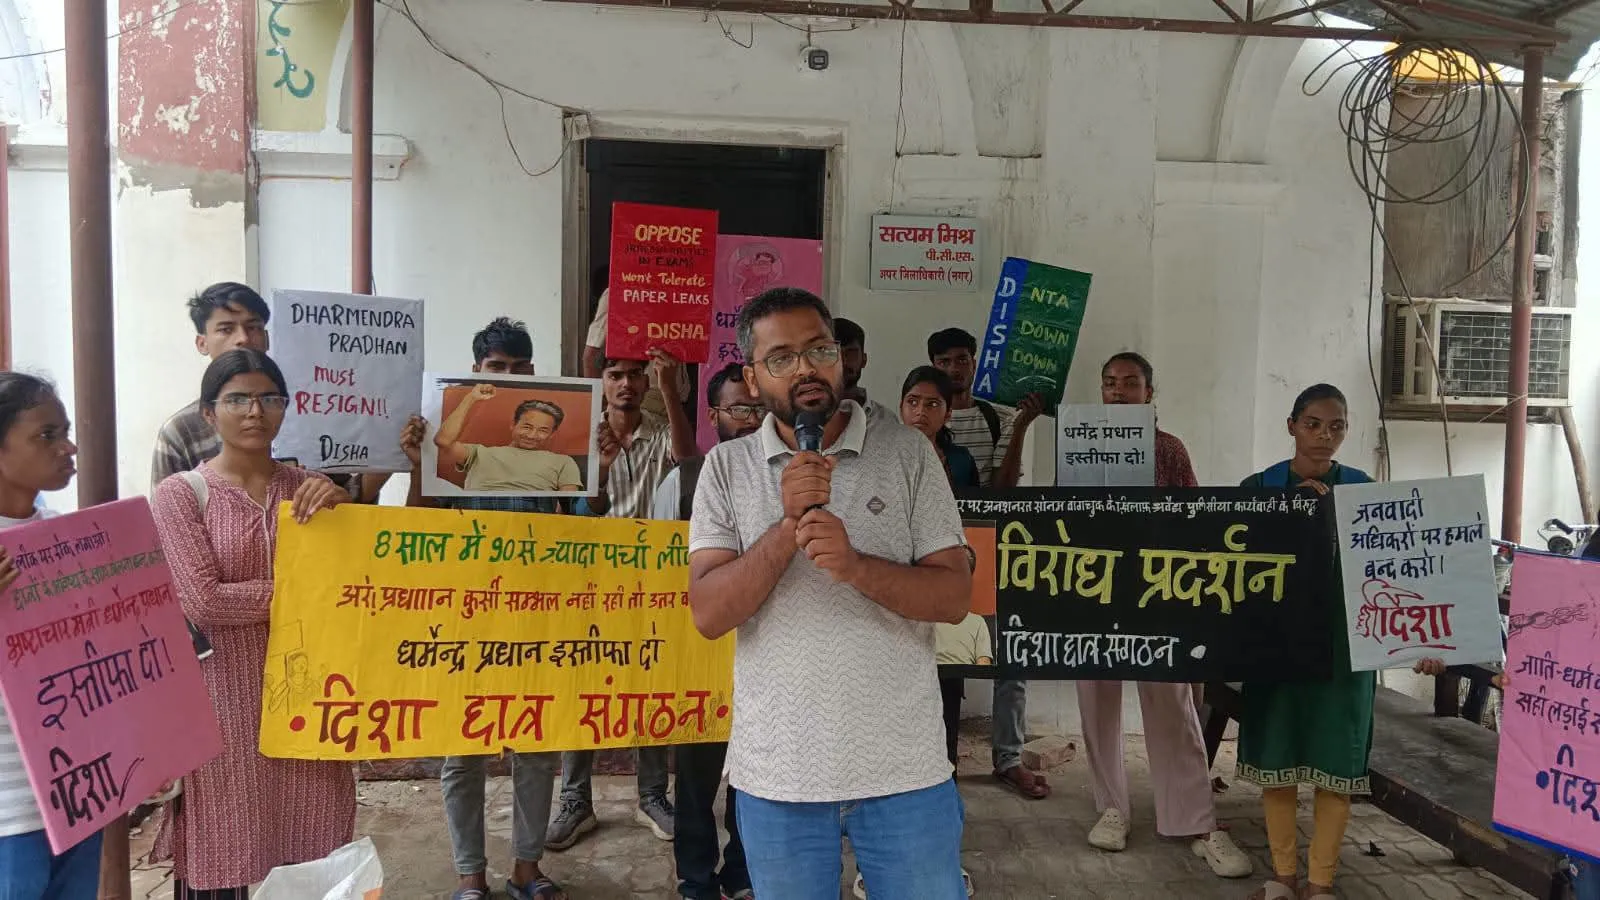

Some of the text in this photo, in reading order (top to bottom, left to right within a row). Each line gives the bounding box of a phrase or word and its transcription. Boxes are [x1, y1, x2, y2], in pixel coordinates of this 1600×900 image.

[635, 224, 703, 245] OPPOSE
[879, 223, 976, 244] सत्यम मिश्र
[926, 248, 974, 262] पी.सी.एस.
[622, 272, 706, 287] Won't Tolerate
[880, 266, 973, 285] अपर जिलाधिकारी (नगर)
[623, 289, 710, 305] PAPER LEAKS
[1030, 287, 1069, 309] NTA
[291, 303, 415, 329] DHARMENDRA
[328, 332, 408, 355] PRADHAN
[977, 276, 1016, 394] DISHA
[1020, 320, 1069, 346] DOWN
[1012, 349, 1058, 374] DOWN
[295, 391, 389, 419] RESIGN!!
[1102, 426, 1144, 439] प्रधान
[1065, 448, 1145, 466] इस्तीफा दो!
[983, 499, 1032, 514] अनशनरत
[1034, 494, 1065, 513] सोनम
[1278, 494, 1289, 513] के
[1352, 488, 1424, 525] जनवादी
[1422, 528, 1441, 545] पर
[1445, 511, 1486, 546] हमले
[395, 531, 455, 565] साल
[458, 519, 487, 561] में
[517, 523, 537, 566] से
[998, 519, 1296, 614] विरोध प्रदर्शन
[1365, 557, 1396, 580] बन्द
[504, 591, 561, 613] सम्भल
[565, 582, 598, 610] नहीं
[603, 584, 625, 613] रही
[628, 581, 646, 609] तो
[648, 591, 676, 609] उतर
[1373, 591, 1455, 644] दिशा
[397, 624, 469, 674] धर्मेन्द्र
[475, 640, 550, 673] प्रधान
[549, 624, 632, 667] इस्तीफा
[1002, 614, 1180, 669] दिशा छात्र संगठन
[313, 673, 712, 754] दिशा छात्र संगठन
[1515, 685, 1550, 717] सही
[1548, 697, 1591, 735] लड़ाई
[49, 746, 121, 828] दिशा
